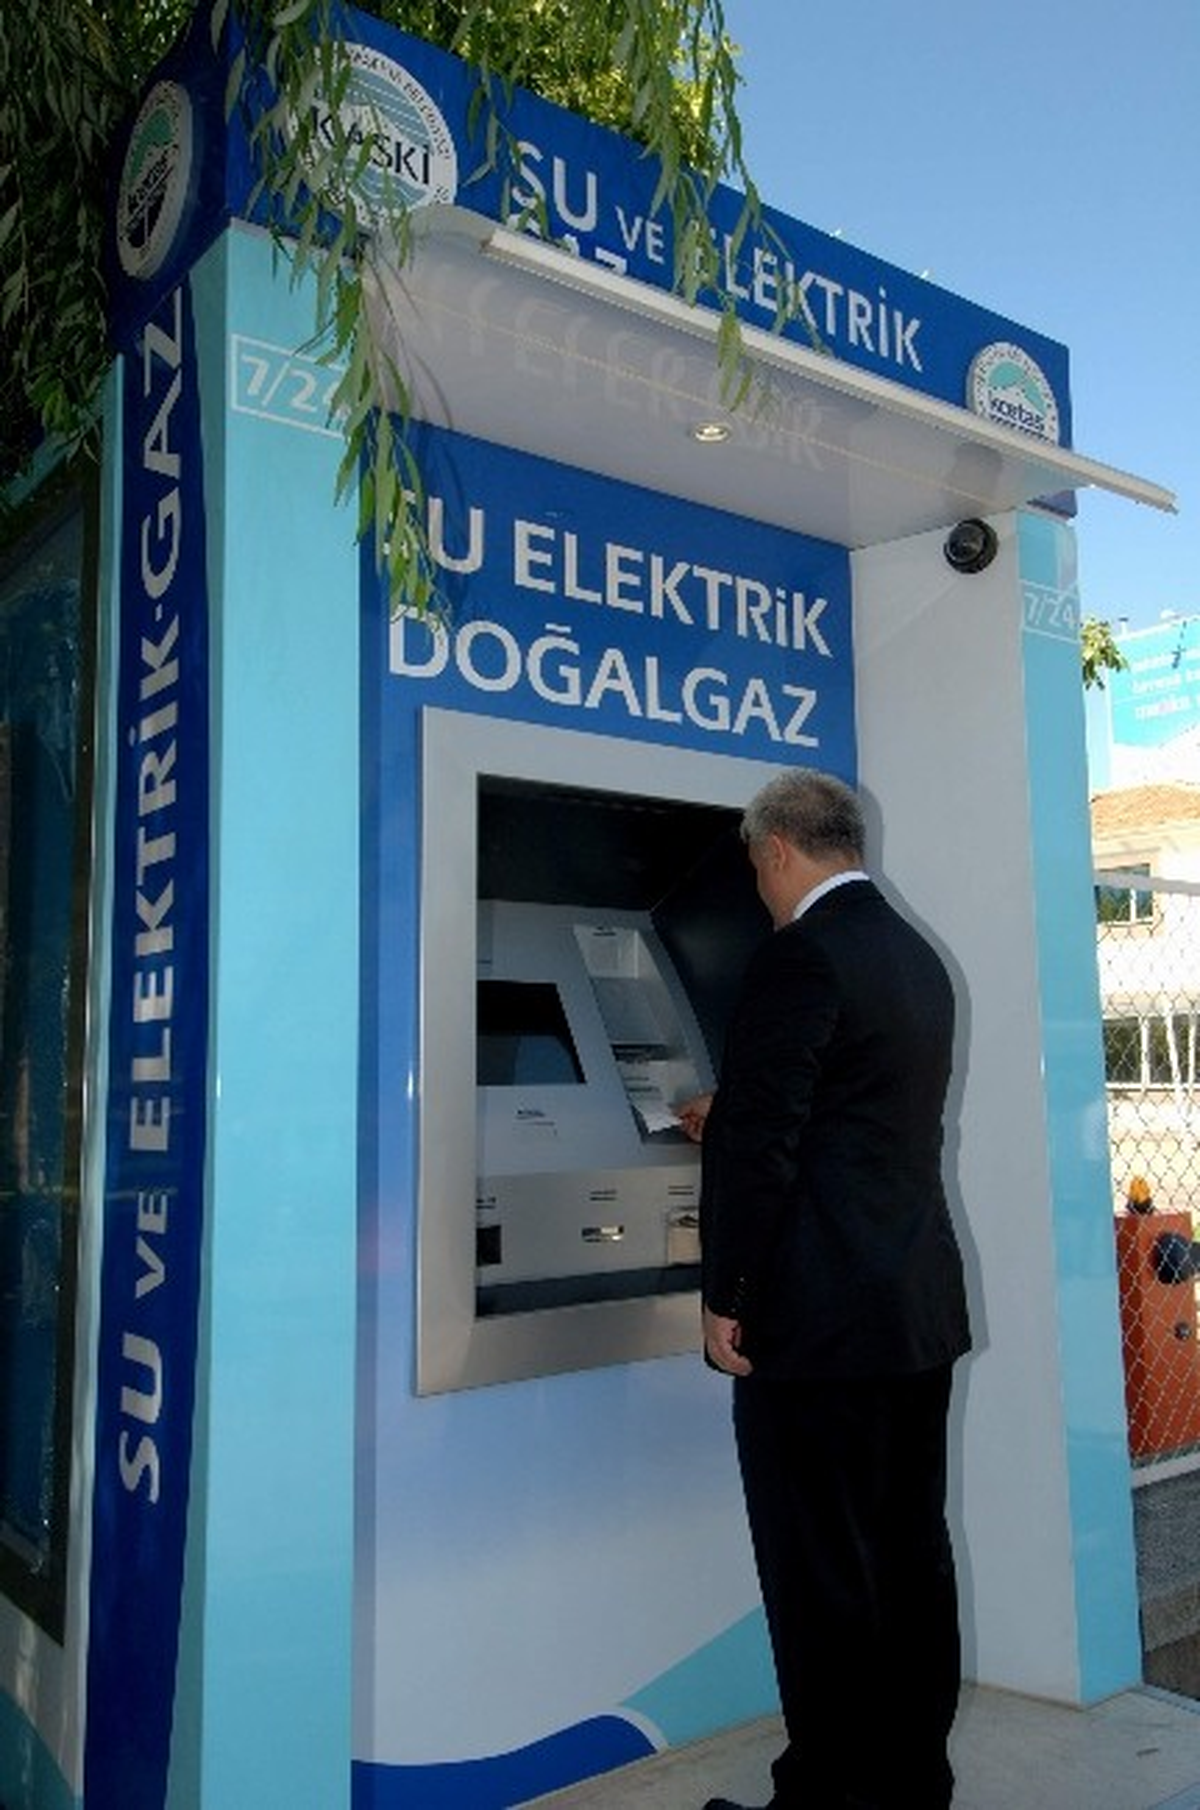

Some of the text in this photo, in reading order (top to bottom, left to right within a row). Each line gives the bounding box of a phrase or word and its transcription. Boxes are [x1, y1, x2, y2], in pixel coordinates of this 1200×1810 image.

[512, 140, 597, 232] SU
[616, 206, 665, 265] VE
[687, 218, 923, 373] LEKTRİK
[389, 603, 819, 748] DOĞALGAZ
[1024, 592, 1075, 630] 7/24
[135, 1192, 169, 1299] VE
[118, 1332, 164, 1504] SU
